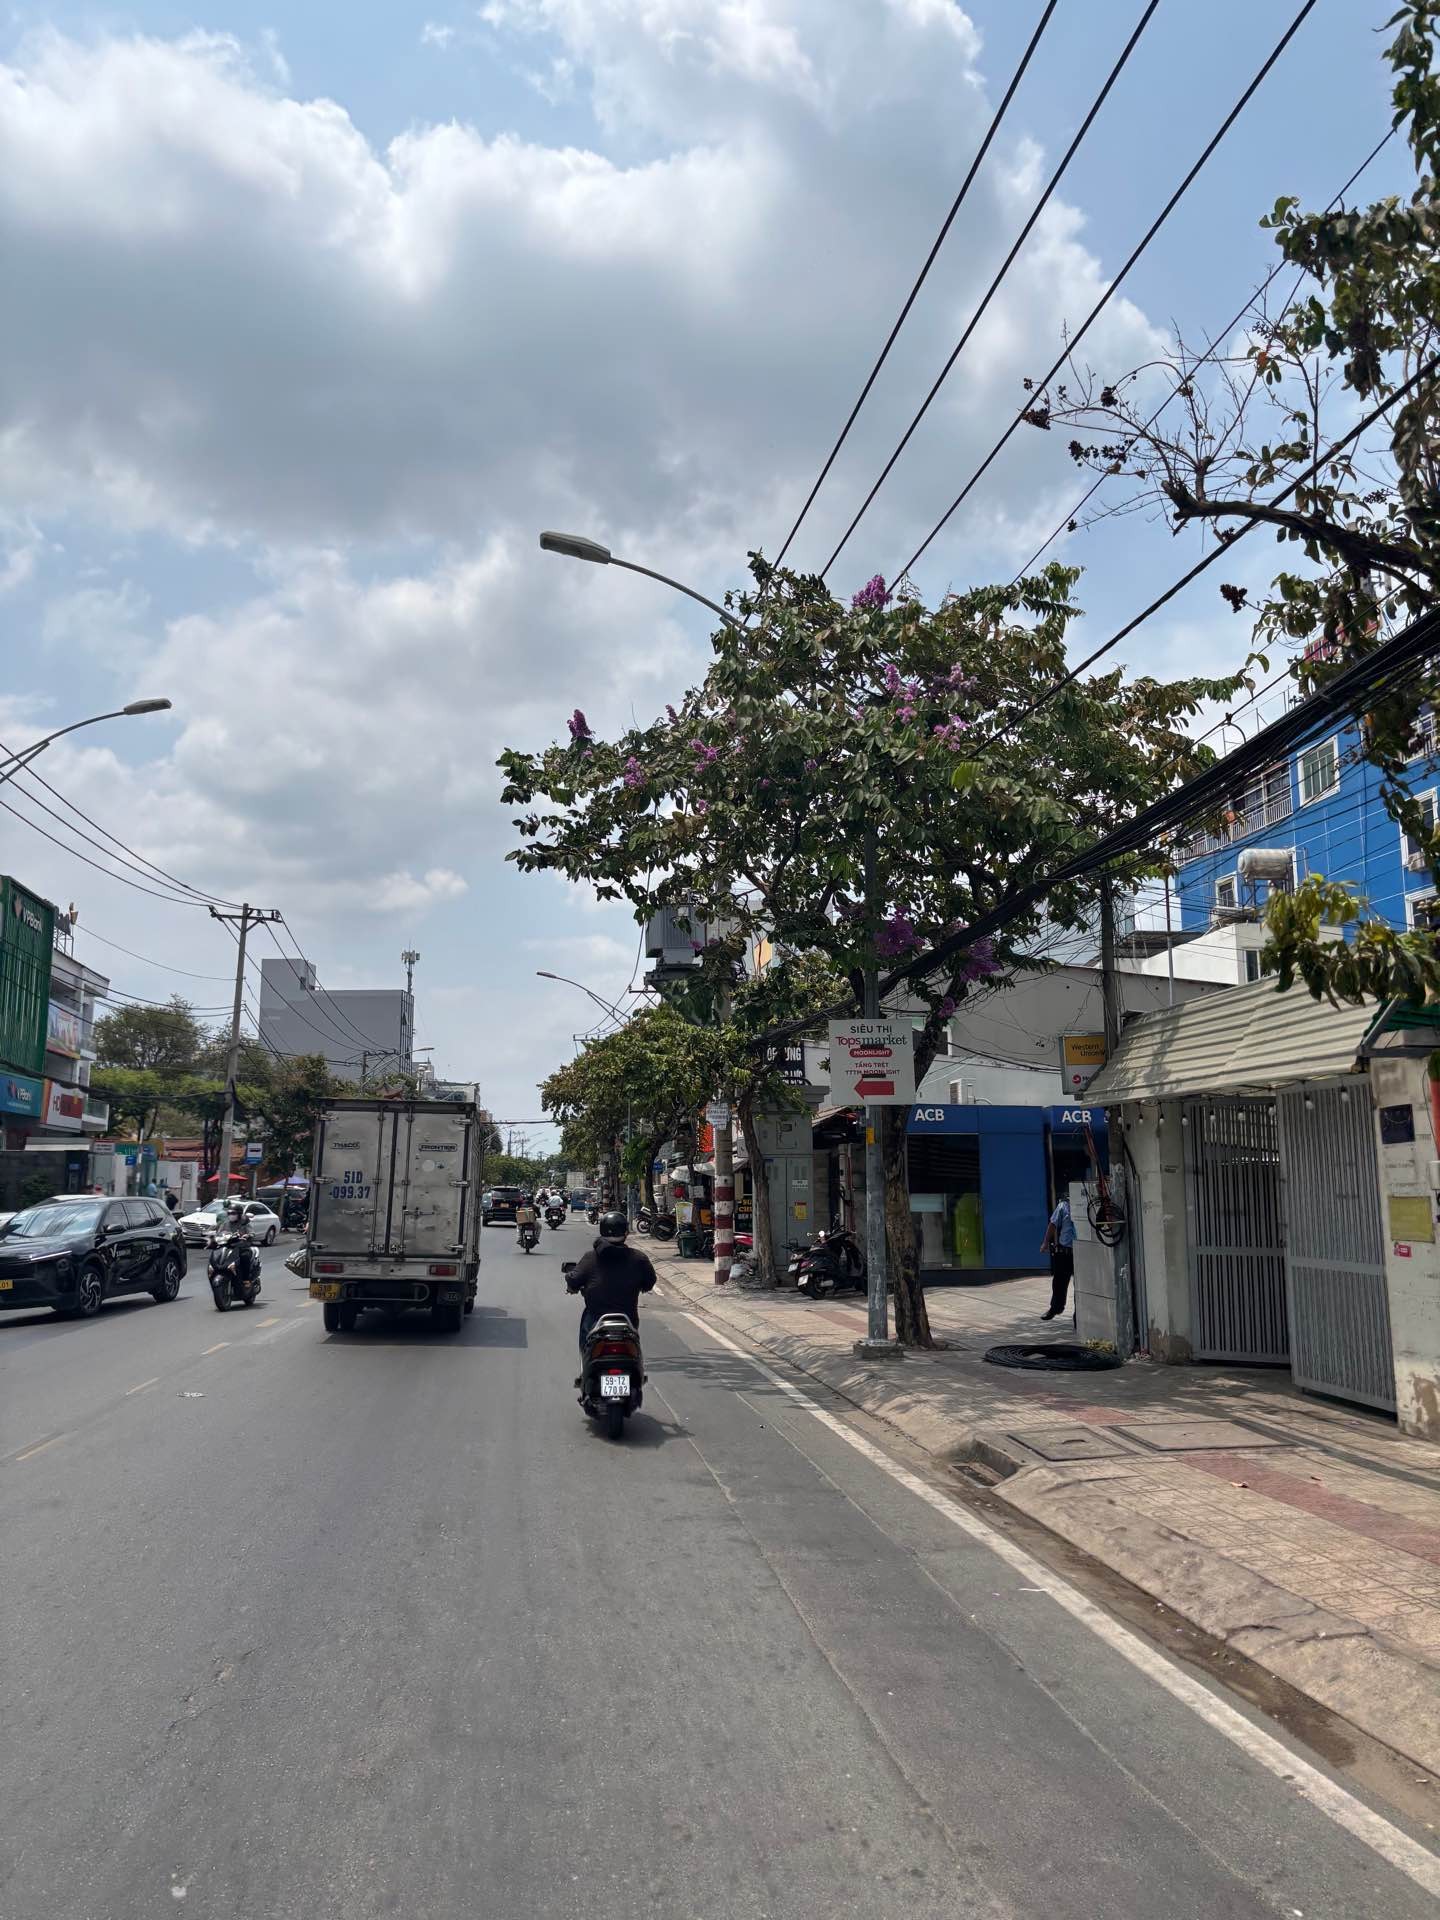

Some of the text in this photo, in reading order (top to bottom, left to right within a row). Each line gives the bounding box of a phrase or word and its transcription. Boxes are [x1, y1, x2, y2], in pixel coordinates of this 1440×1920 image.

[850, 1024, 893, 1035] SIÊU THỊ
[853, 1049, 890, 1057] MOONLIGHT
[914, 1108, 945, 1122] ACB
[1061, 1110, 1092, 1123] ACB
[344, 1170, 363, 1184] 51D
